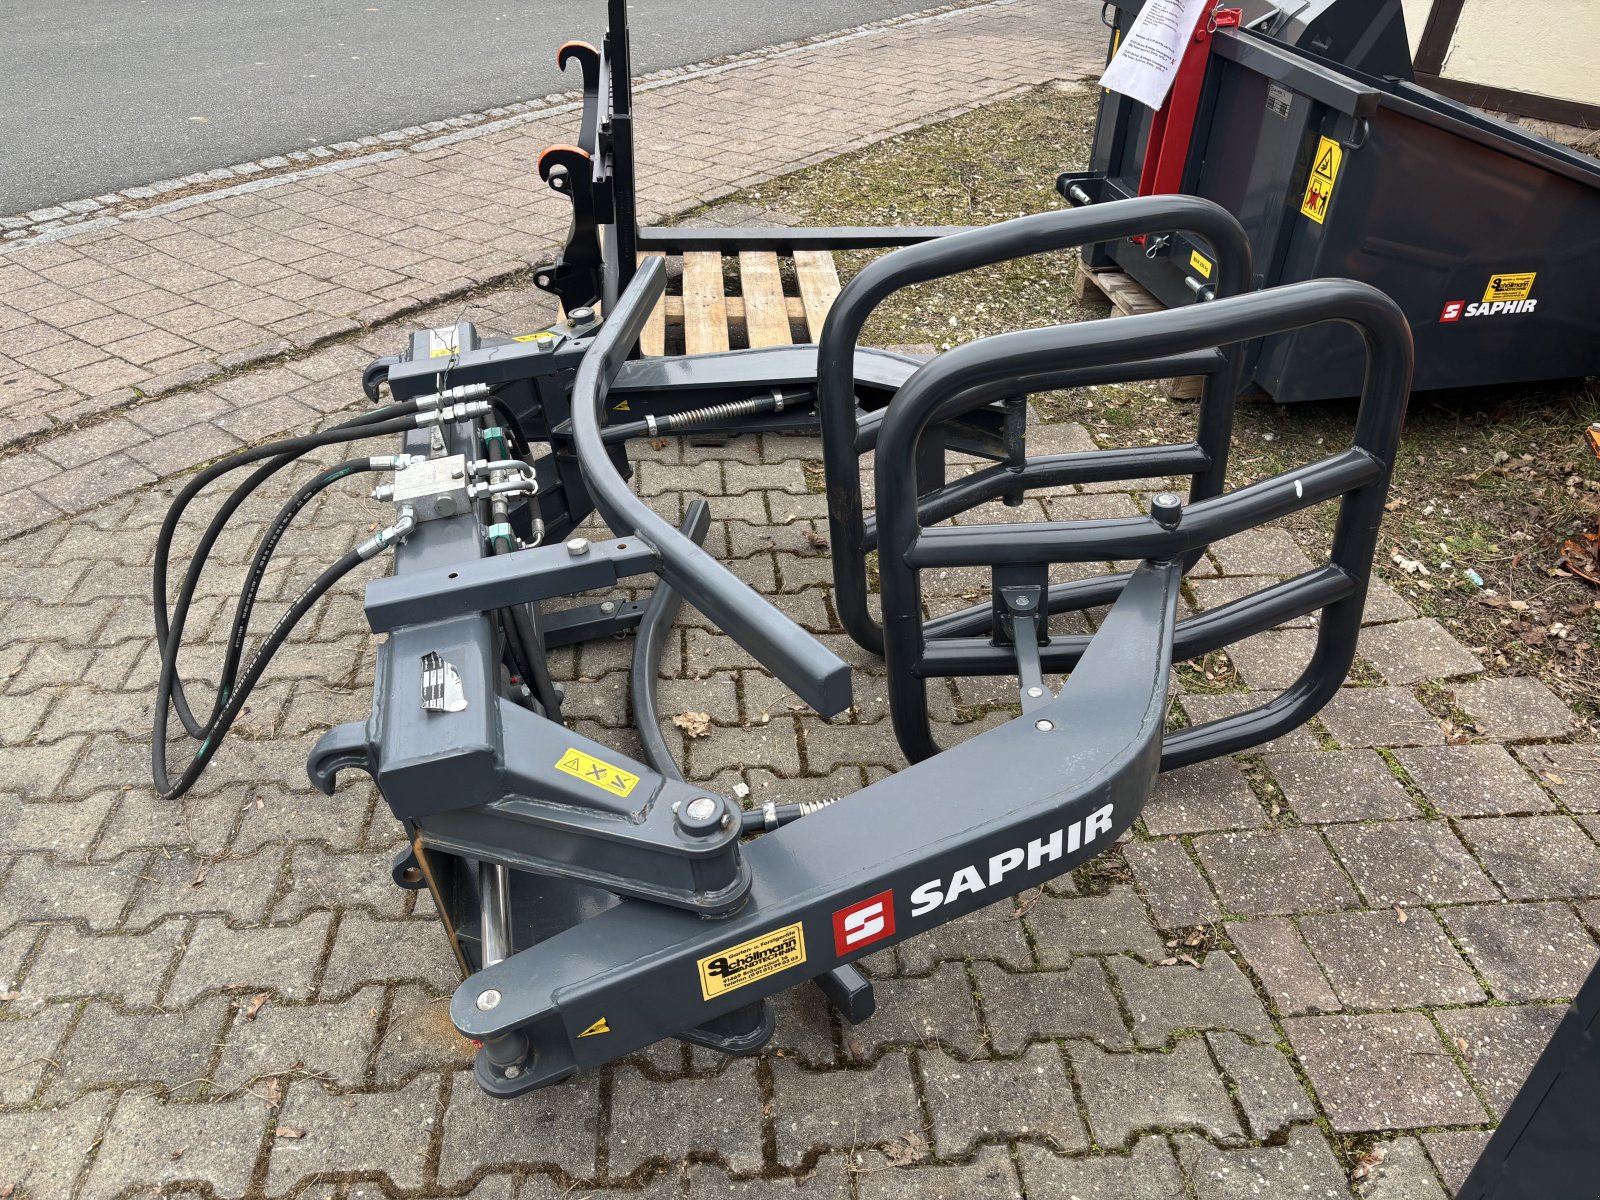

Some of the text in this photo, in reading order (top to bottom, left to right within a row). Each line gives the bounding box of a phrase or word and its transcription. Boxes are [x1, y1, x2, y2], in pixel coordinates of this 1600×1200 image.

[1464, 299, 1537, 317] SAPHIR
[910, 803, 1114, 917] SAPHIR
[708, 939, 797, 977] Schöllmann
[728, 947, 753, 959] Garten-
[760, 930, 796, 947] Forstgeräte
[721, 946, 797, 979] LANDTECHNIK
[723, 974, 742, 984] 91469
[743, 959, 780, 976] Bräuersdorf
[723, 976, 747, 988] Telefon
